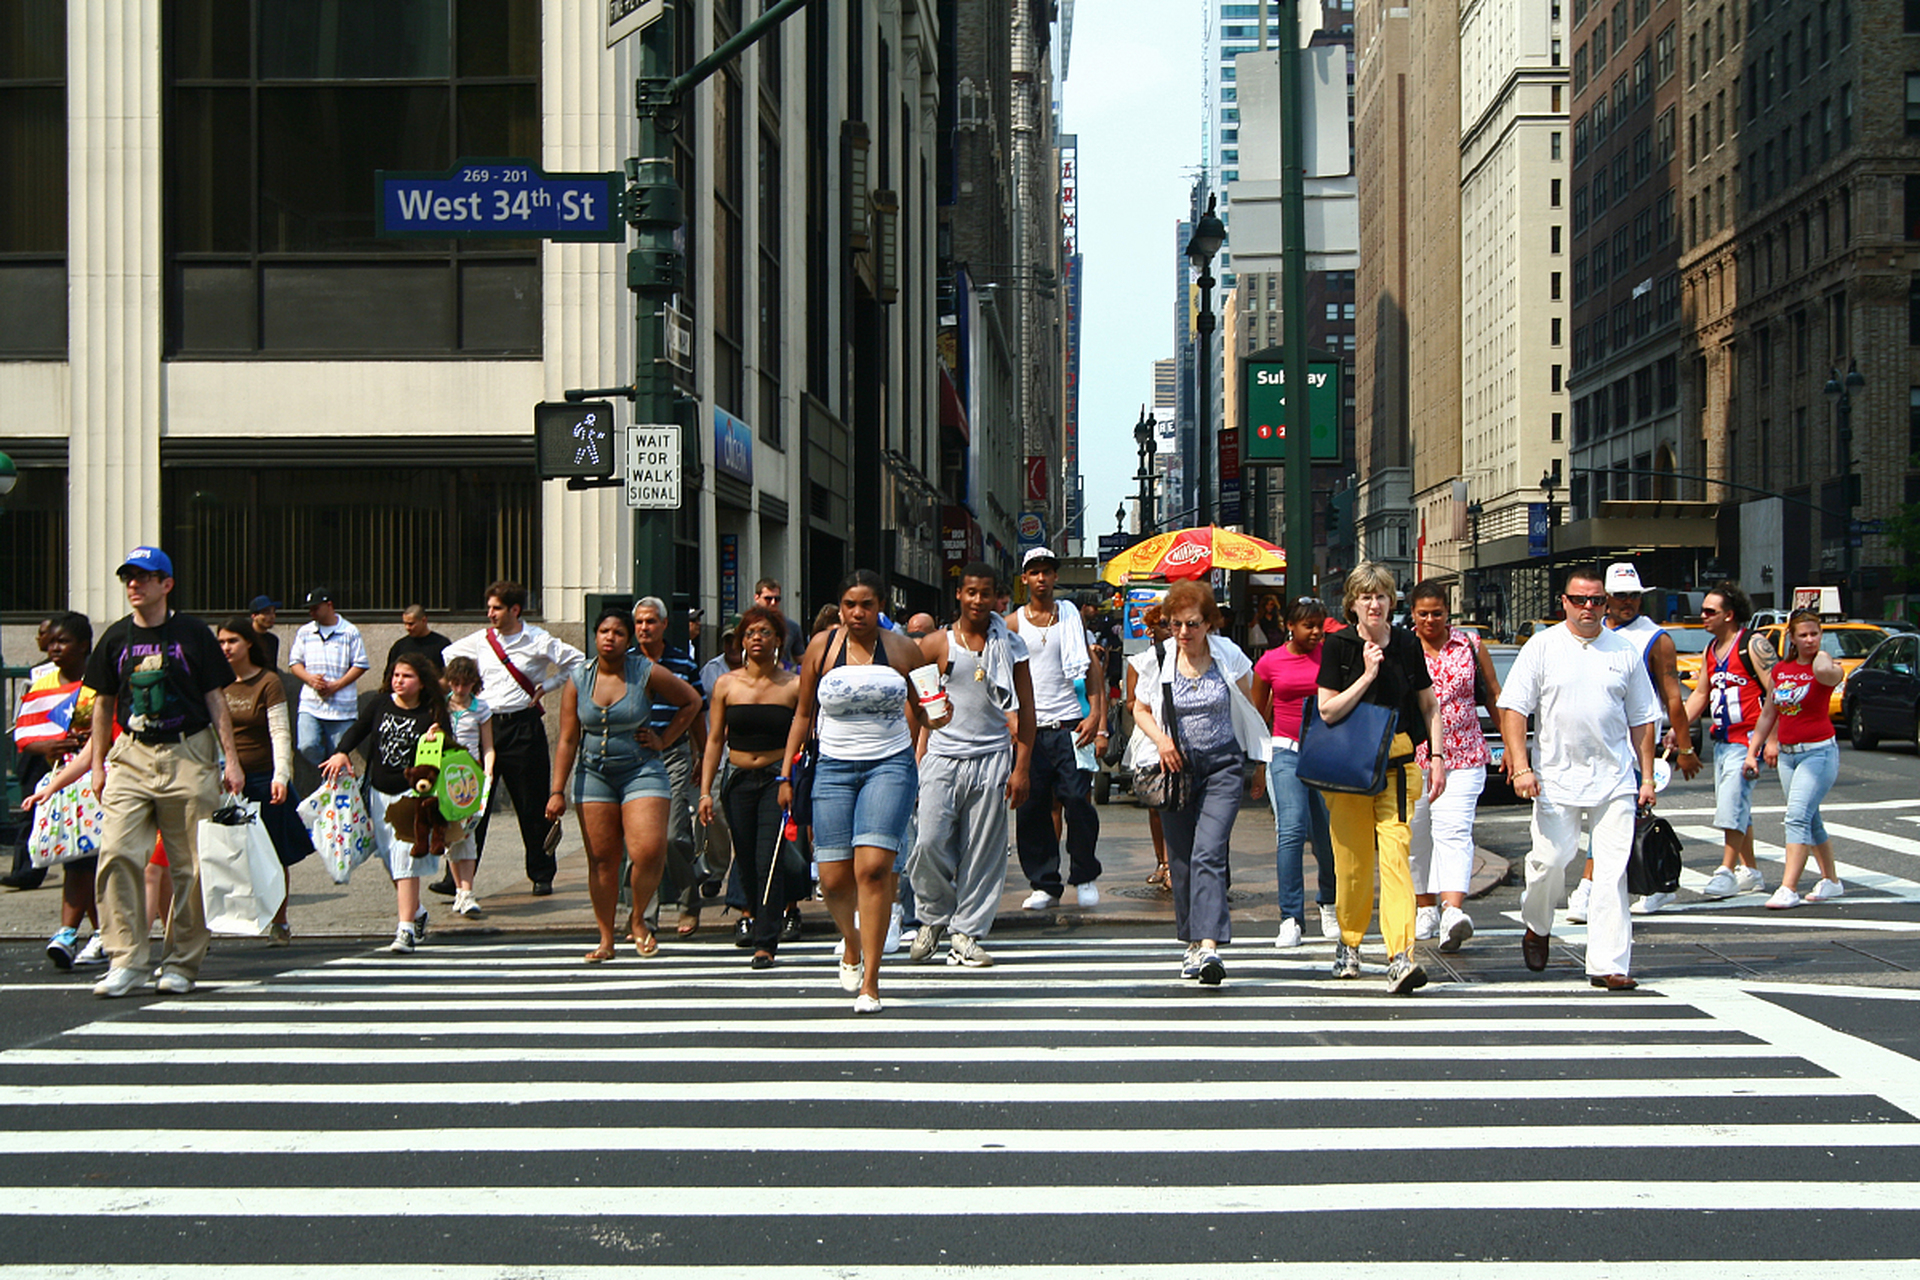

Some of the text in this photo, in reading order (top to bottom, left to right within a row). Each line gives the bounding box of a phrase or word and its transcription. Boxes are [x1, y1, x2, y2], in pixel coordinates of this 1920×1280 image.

[463, 170, 489, 183] 269
[502, 170, 528, 183] 201
[398, 187, 595, 221] West 34th St
[636, 435, 670, 447] WAIT
[638, 452, 667, 464] FOR
[633, 470, 673, 482] WALK
[630, 486, 675, 499] SIGNAL
